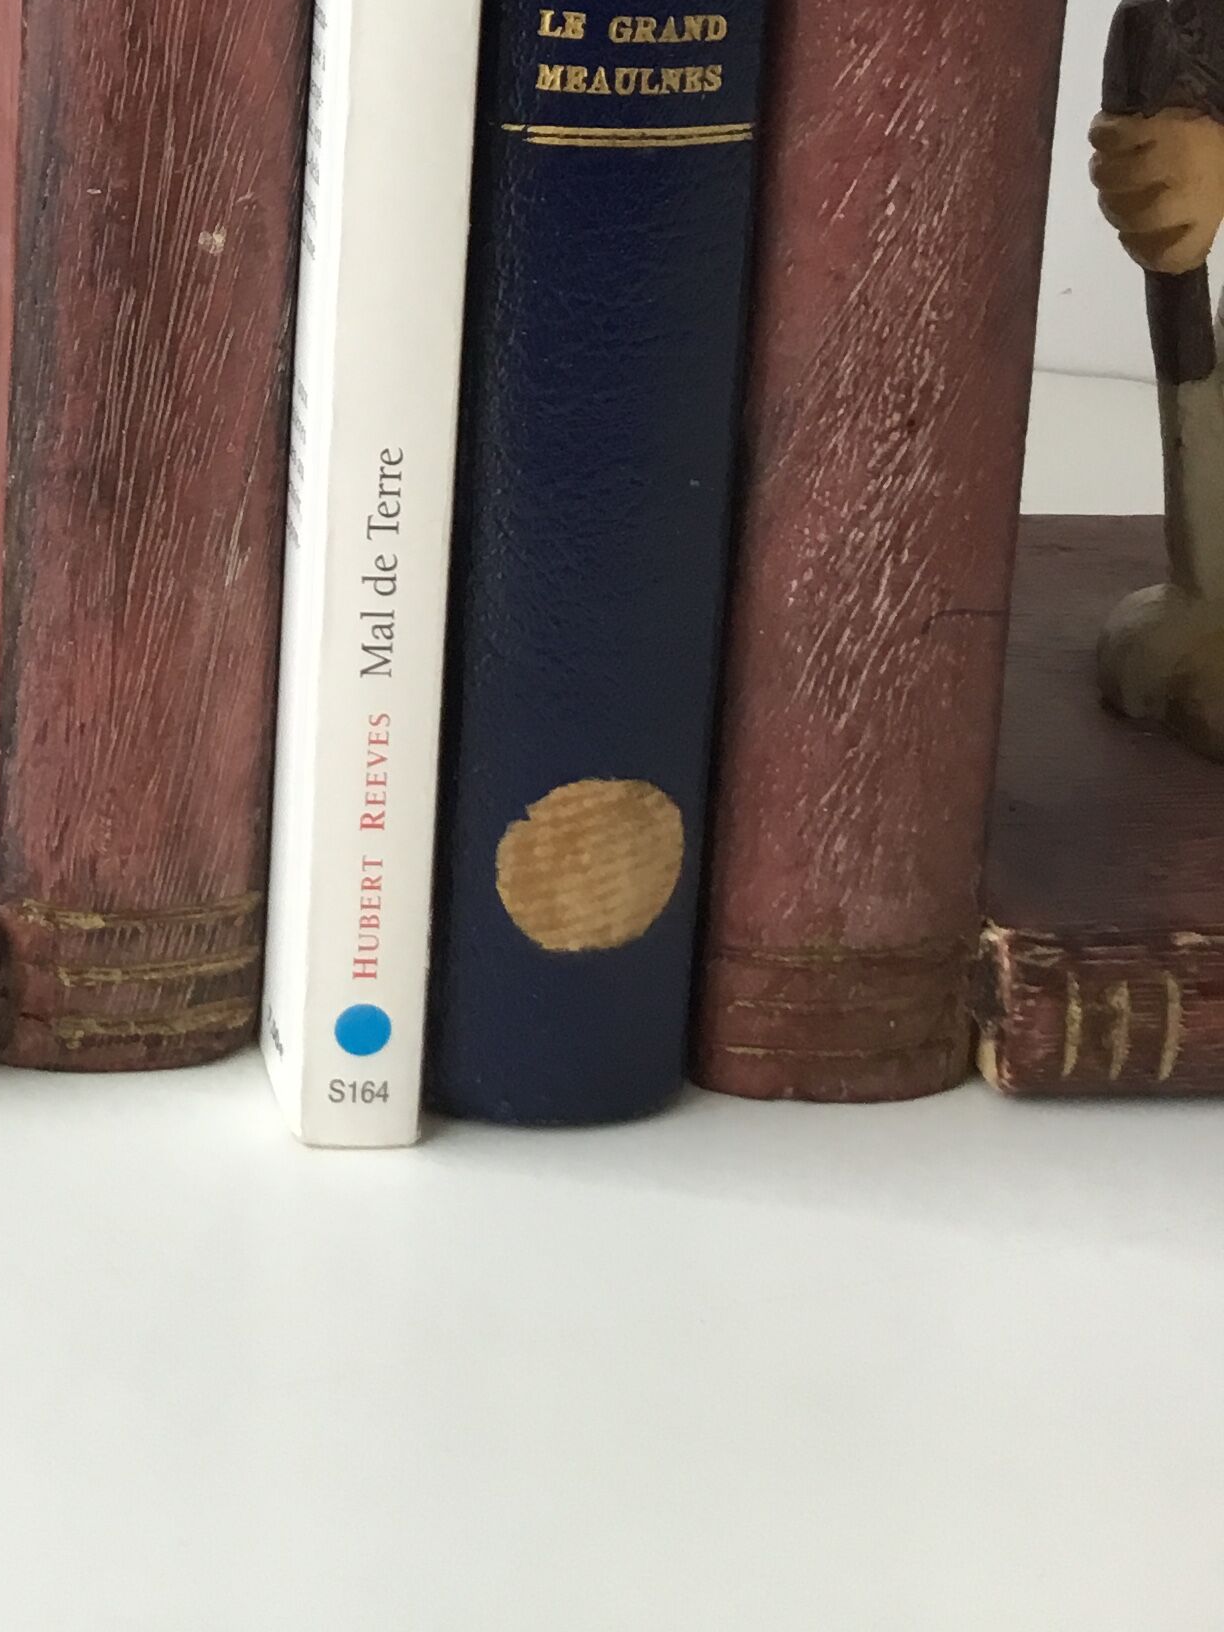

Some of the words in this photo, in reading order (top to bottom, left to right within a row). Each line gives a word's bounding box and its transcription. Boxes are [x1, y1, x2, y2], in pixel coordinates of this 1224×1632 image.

[536, 9, 588, 41] LE
[608, 13, 729, 44] GRAND
[535, 62, 723, 97] MEAULNES
[365, 446, 405, 541] Terre
[361, 553, 398, 597] de
[359, 609, 395, 679] Mal
[358, 711, 393, 833] REEVES
[351, 855, 384, 981] HUBERT
[327, 1079, 390, 1104] S164
